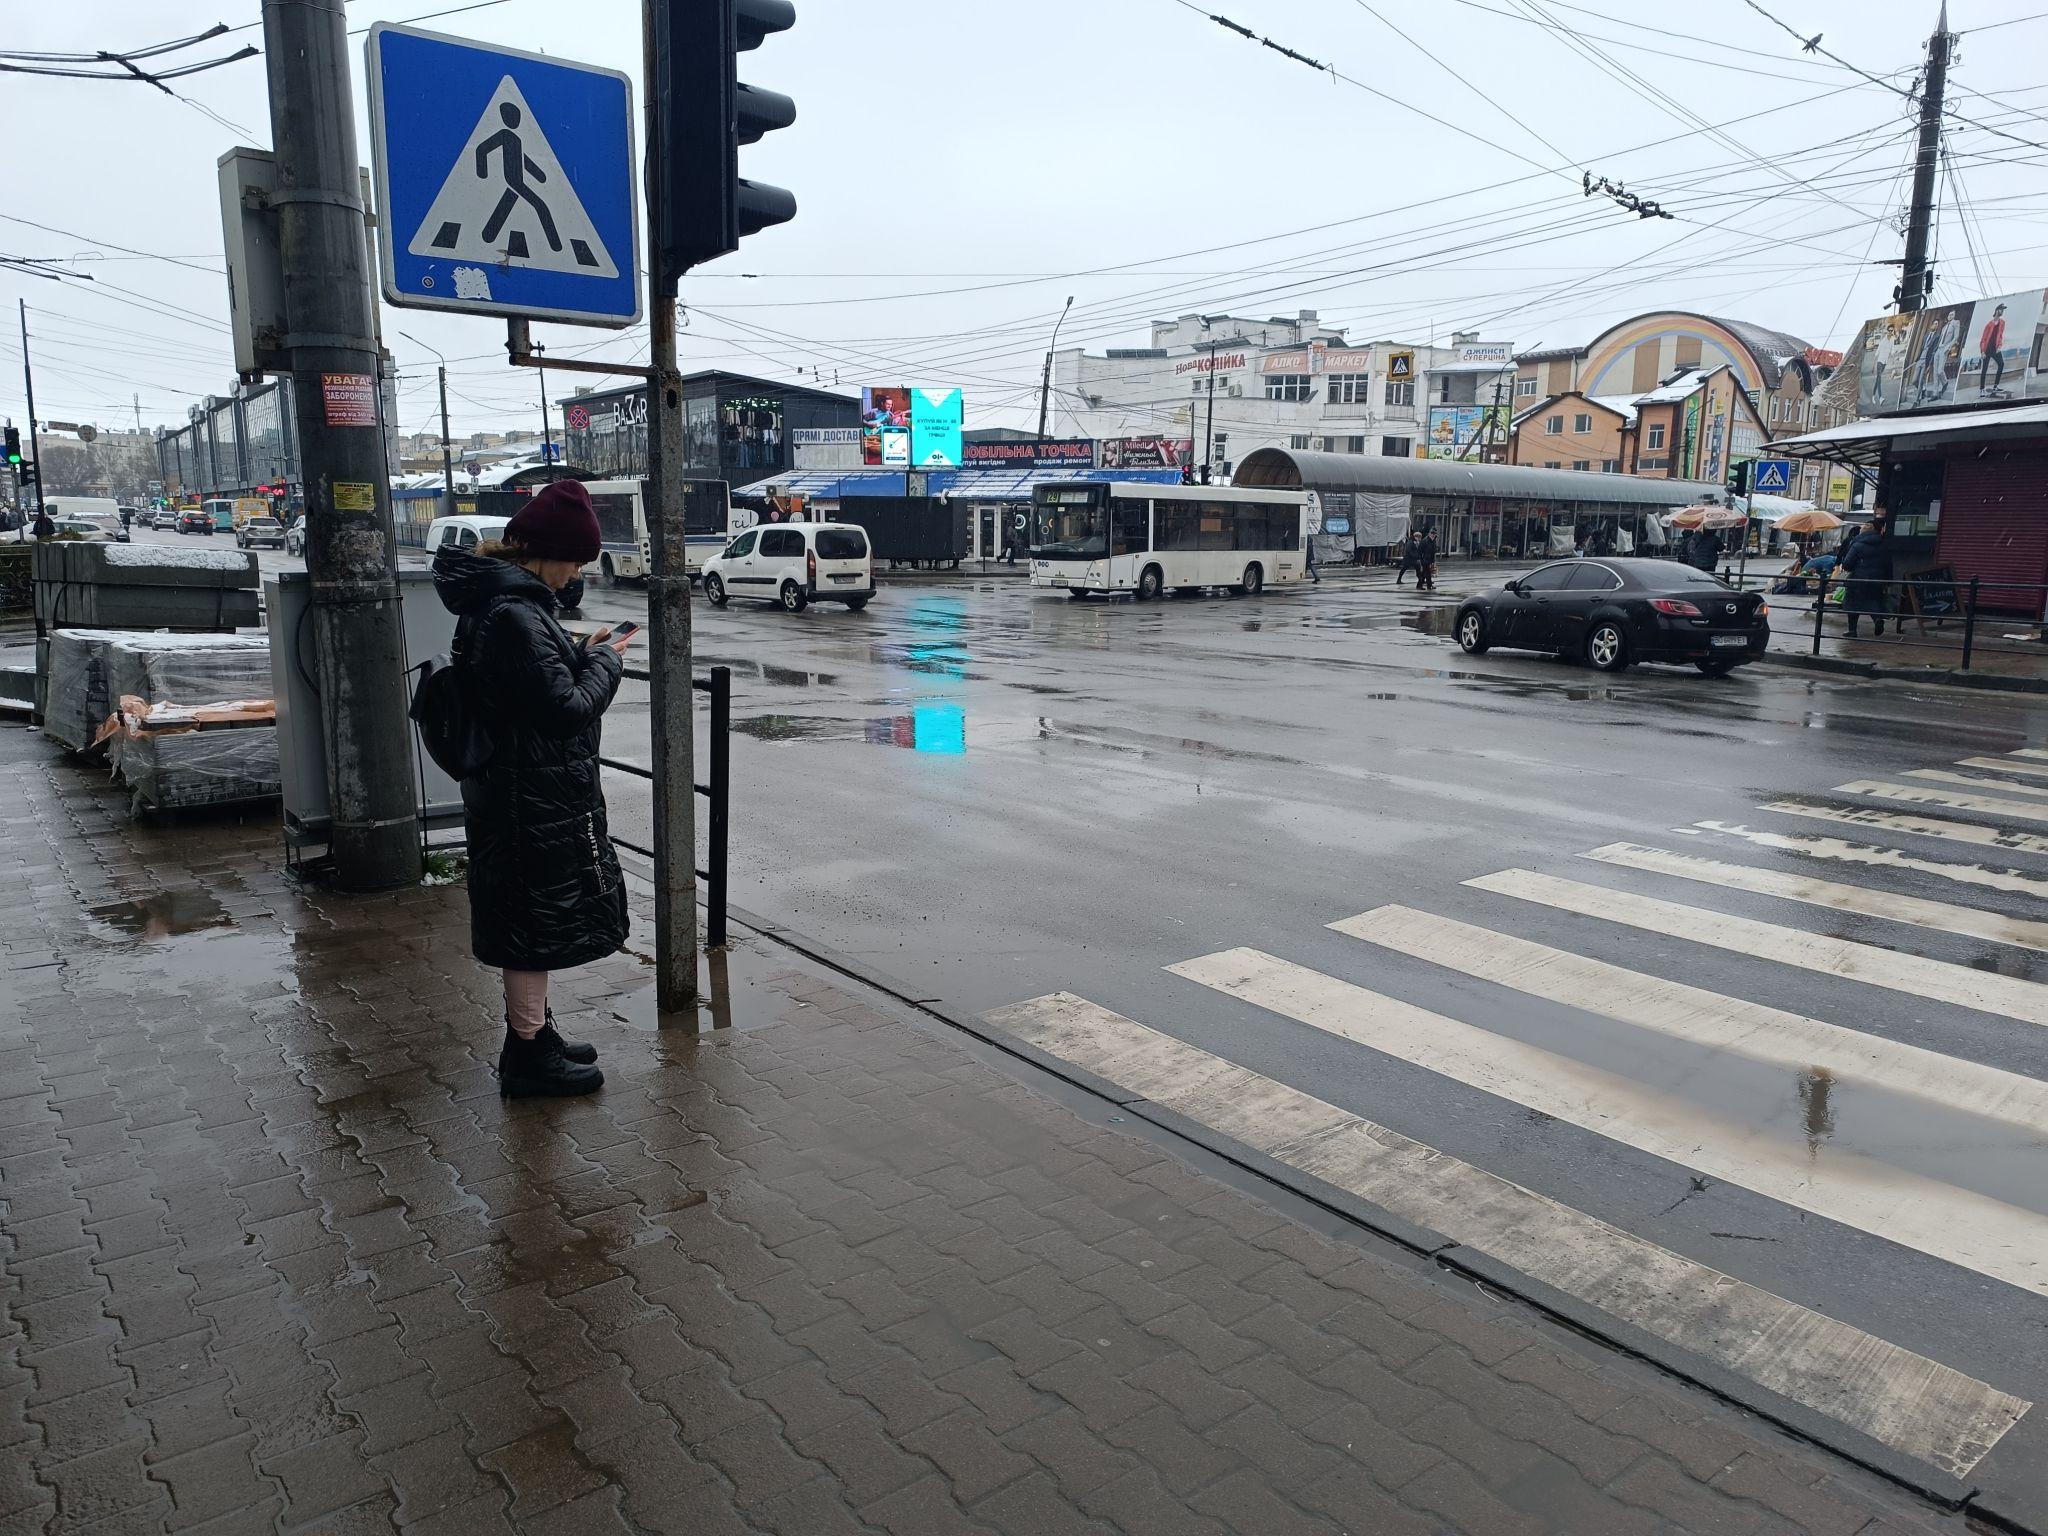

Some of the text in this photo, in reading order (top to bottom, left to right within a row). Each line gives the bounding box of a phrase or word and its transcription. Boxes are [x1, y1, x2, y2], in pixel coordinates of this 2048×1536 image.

[1175, 353, 1246, 375] Нова КОПІЙКА
[1271, 356, 1300, 368] АЛКО
[1325, 355, 1367, 368] МАРКЕТ
[793, 430, 821, 442] ПРЯМІ
[1038, 444, 1092, 457] ТОЧКА
